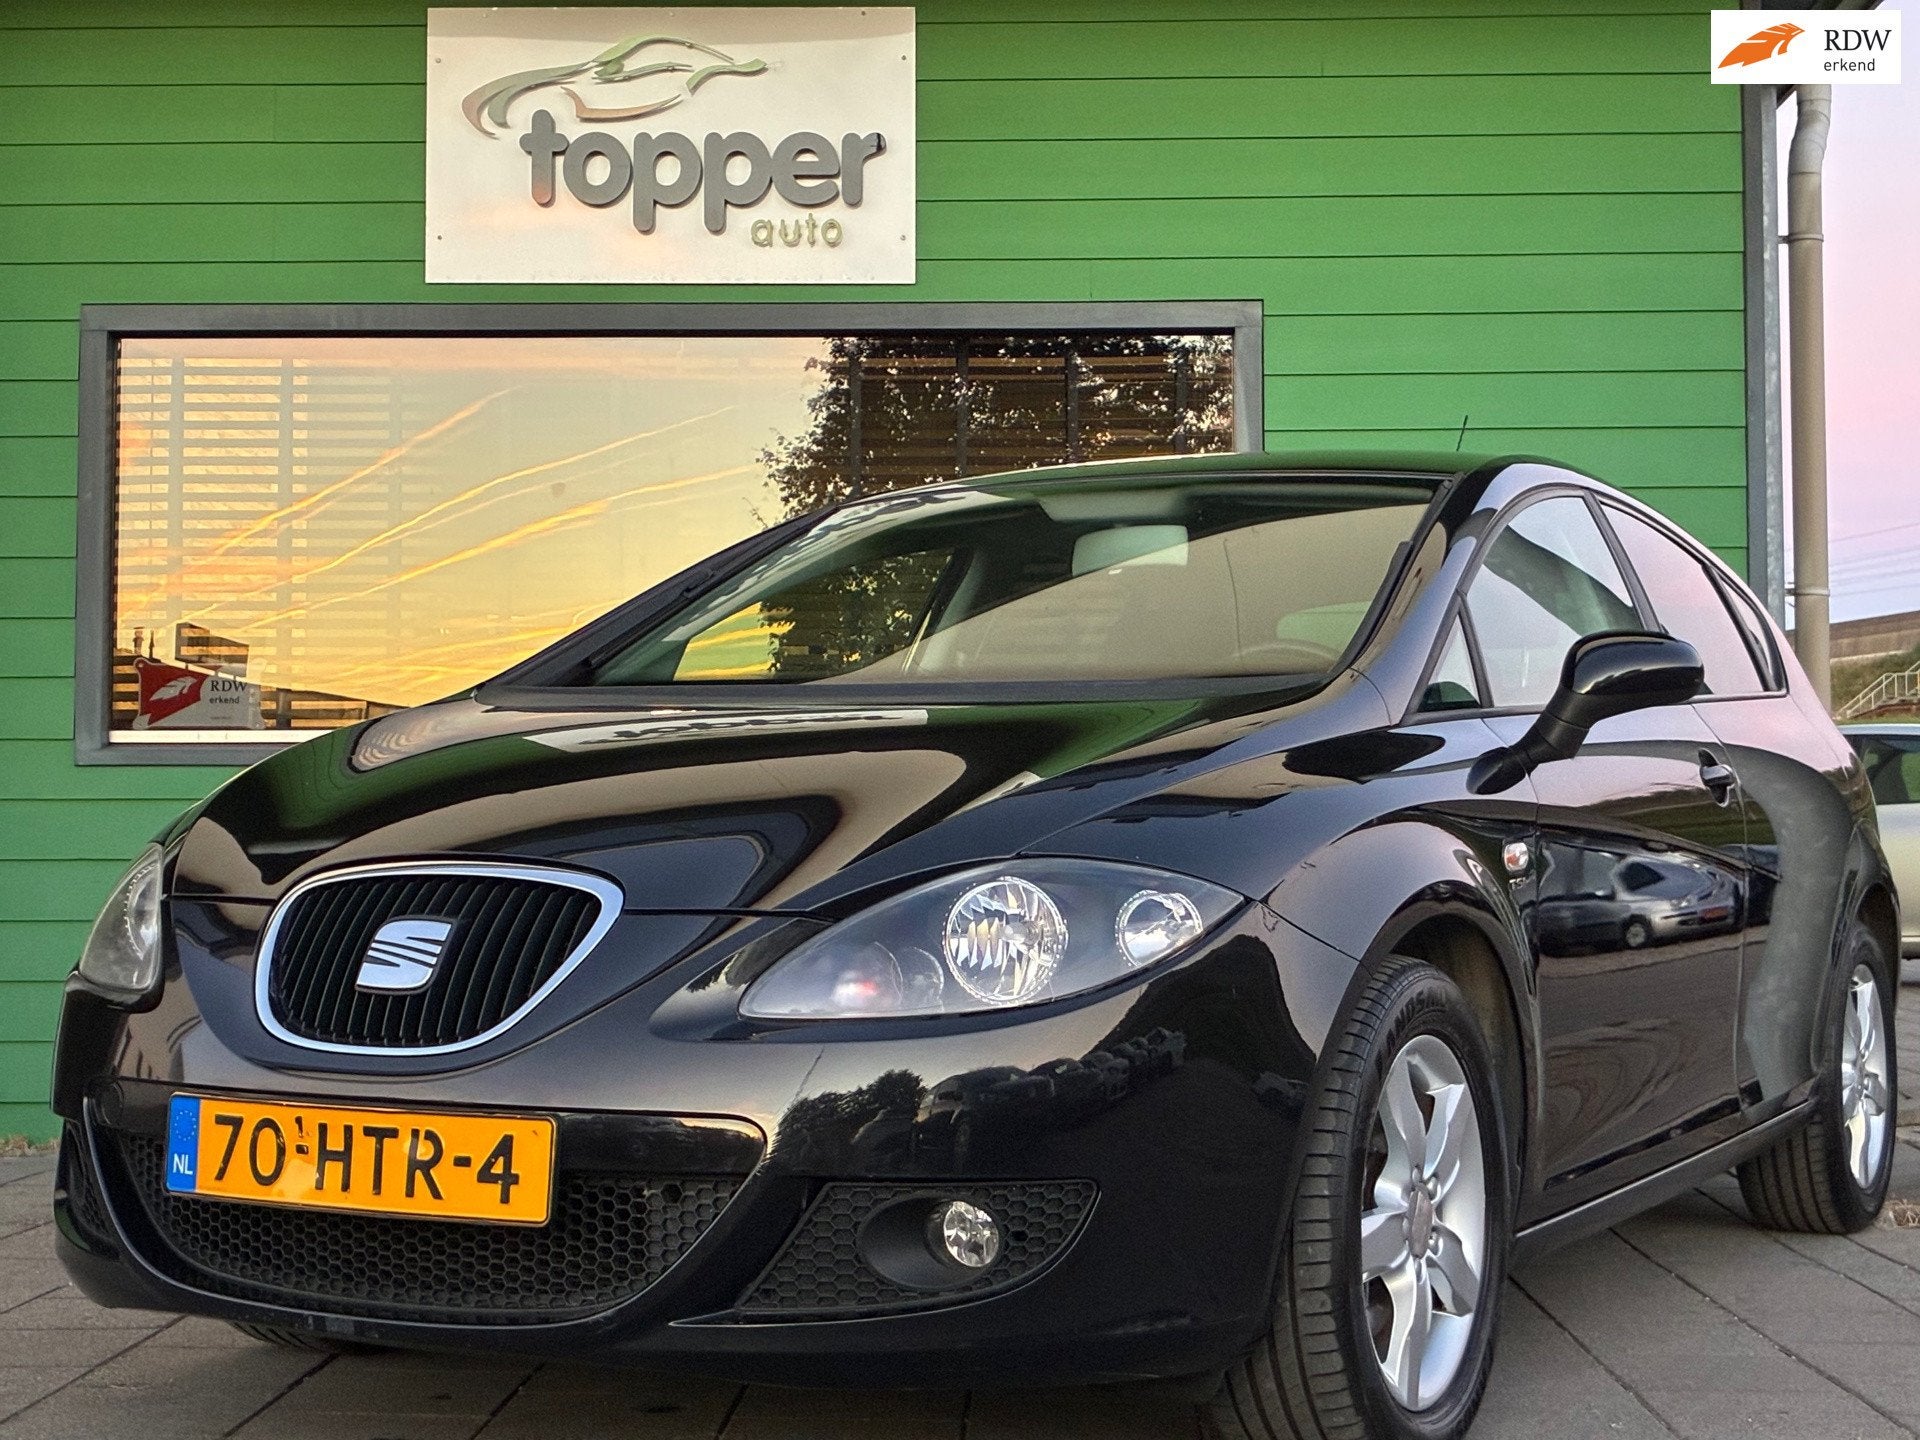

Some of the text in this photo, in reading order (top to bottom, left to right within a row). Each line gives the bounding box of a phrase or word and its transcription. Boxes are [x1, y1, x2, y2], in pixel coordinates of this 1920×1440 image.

[519, 109, 887, 233] topper
[751, 213, 843, 248] auto
[209, 695, 240, 704] erkend
[210, 680, 247, 692] RDW
[172, 1155, 193, 1175] NL
[214, 1113, 520, 1204] 70-HTR-4
